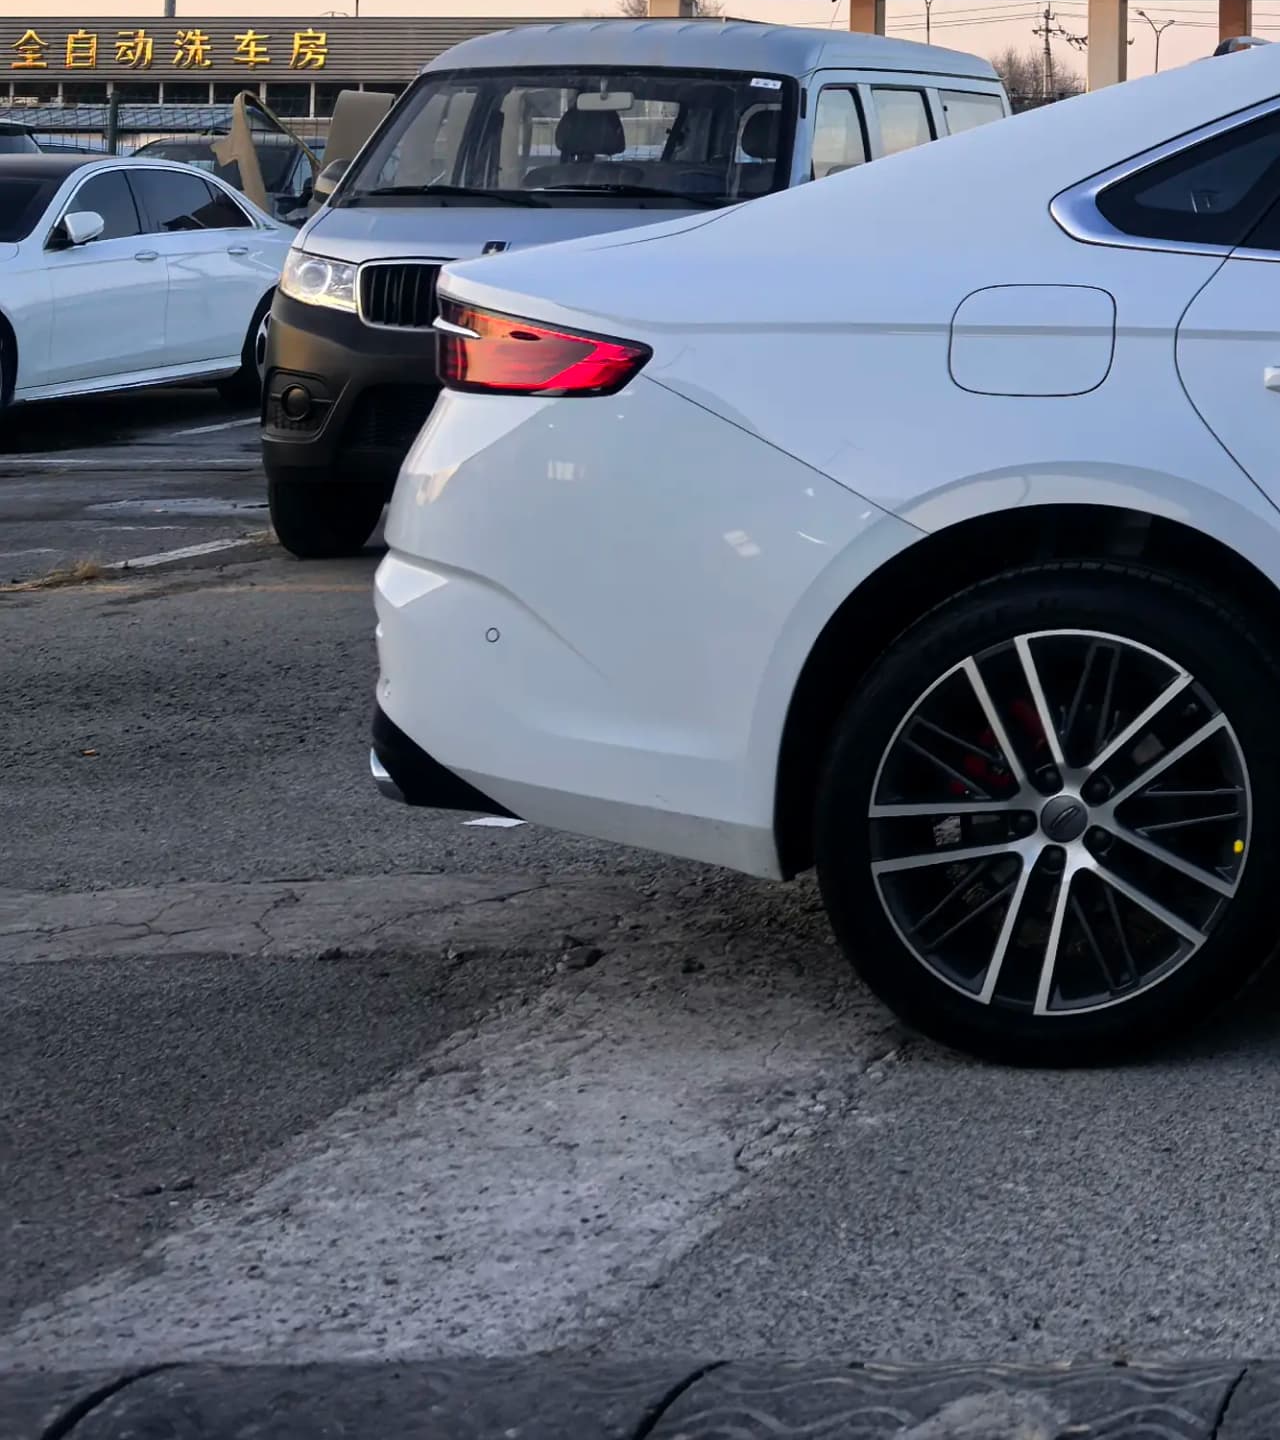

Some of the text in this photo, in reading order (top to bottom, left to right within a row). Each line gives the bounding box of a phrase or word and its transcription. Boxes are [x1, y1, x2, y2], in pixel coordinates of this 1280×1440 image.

[11, 29, 328, 69] 全自动洗车房
